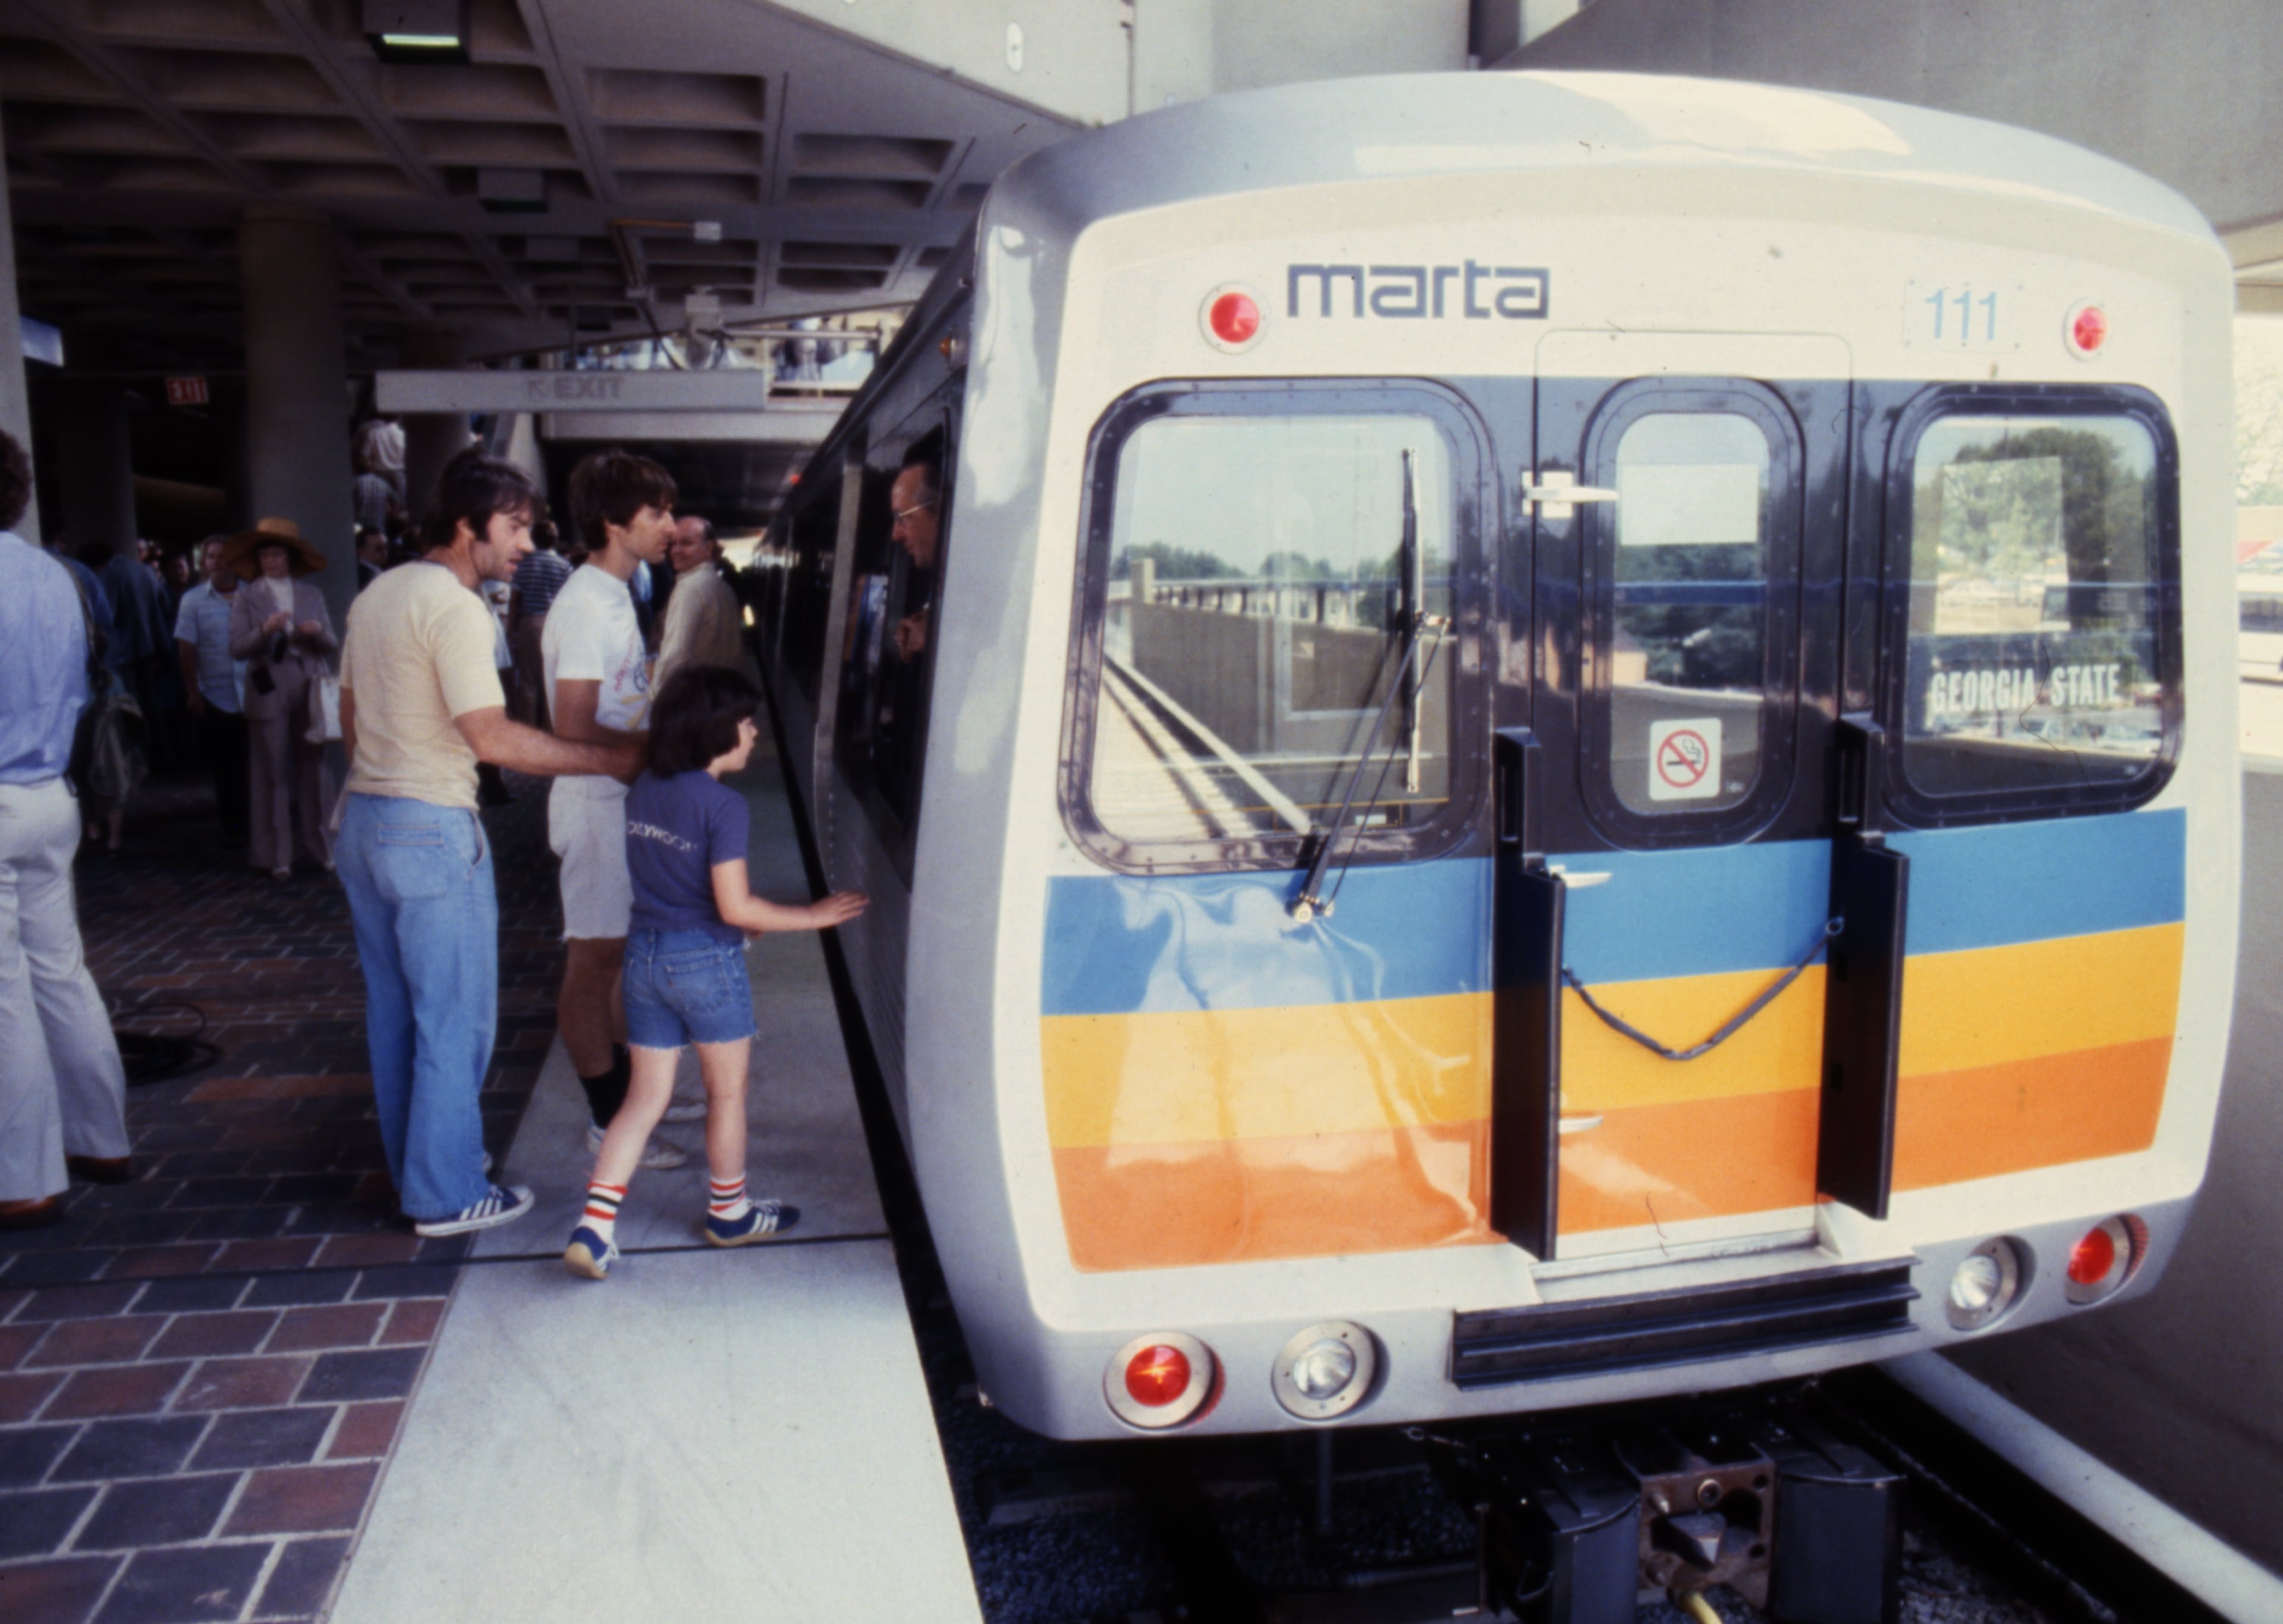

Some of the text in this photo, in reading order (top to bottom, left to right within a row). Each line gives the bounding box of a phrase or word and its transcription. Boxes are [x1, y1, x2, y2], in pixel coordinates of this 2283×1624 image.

[1287, 259, 1551, 319] marta
[1925, 288, 1998, 341] 111
[168, 379, 207, 401] EXIT
[554, 375, 625, 399] EXIT
[1930, 663, 2122, 713] GEORGIA STATE
